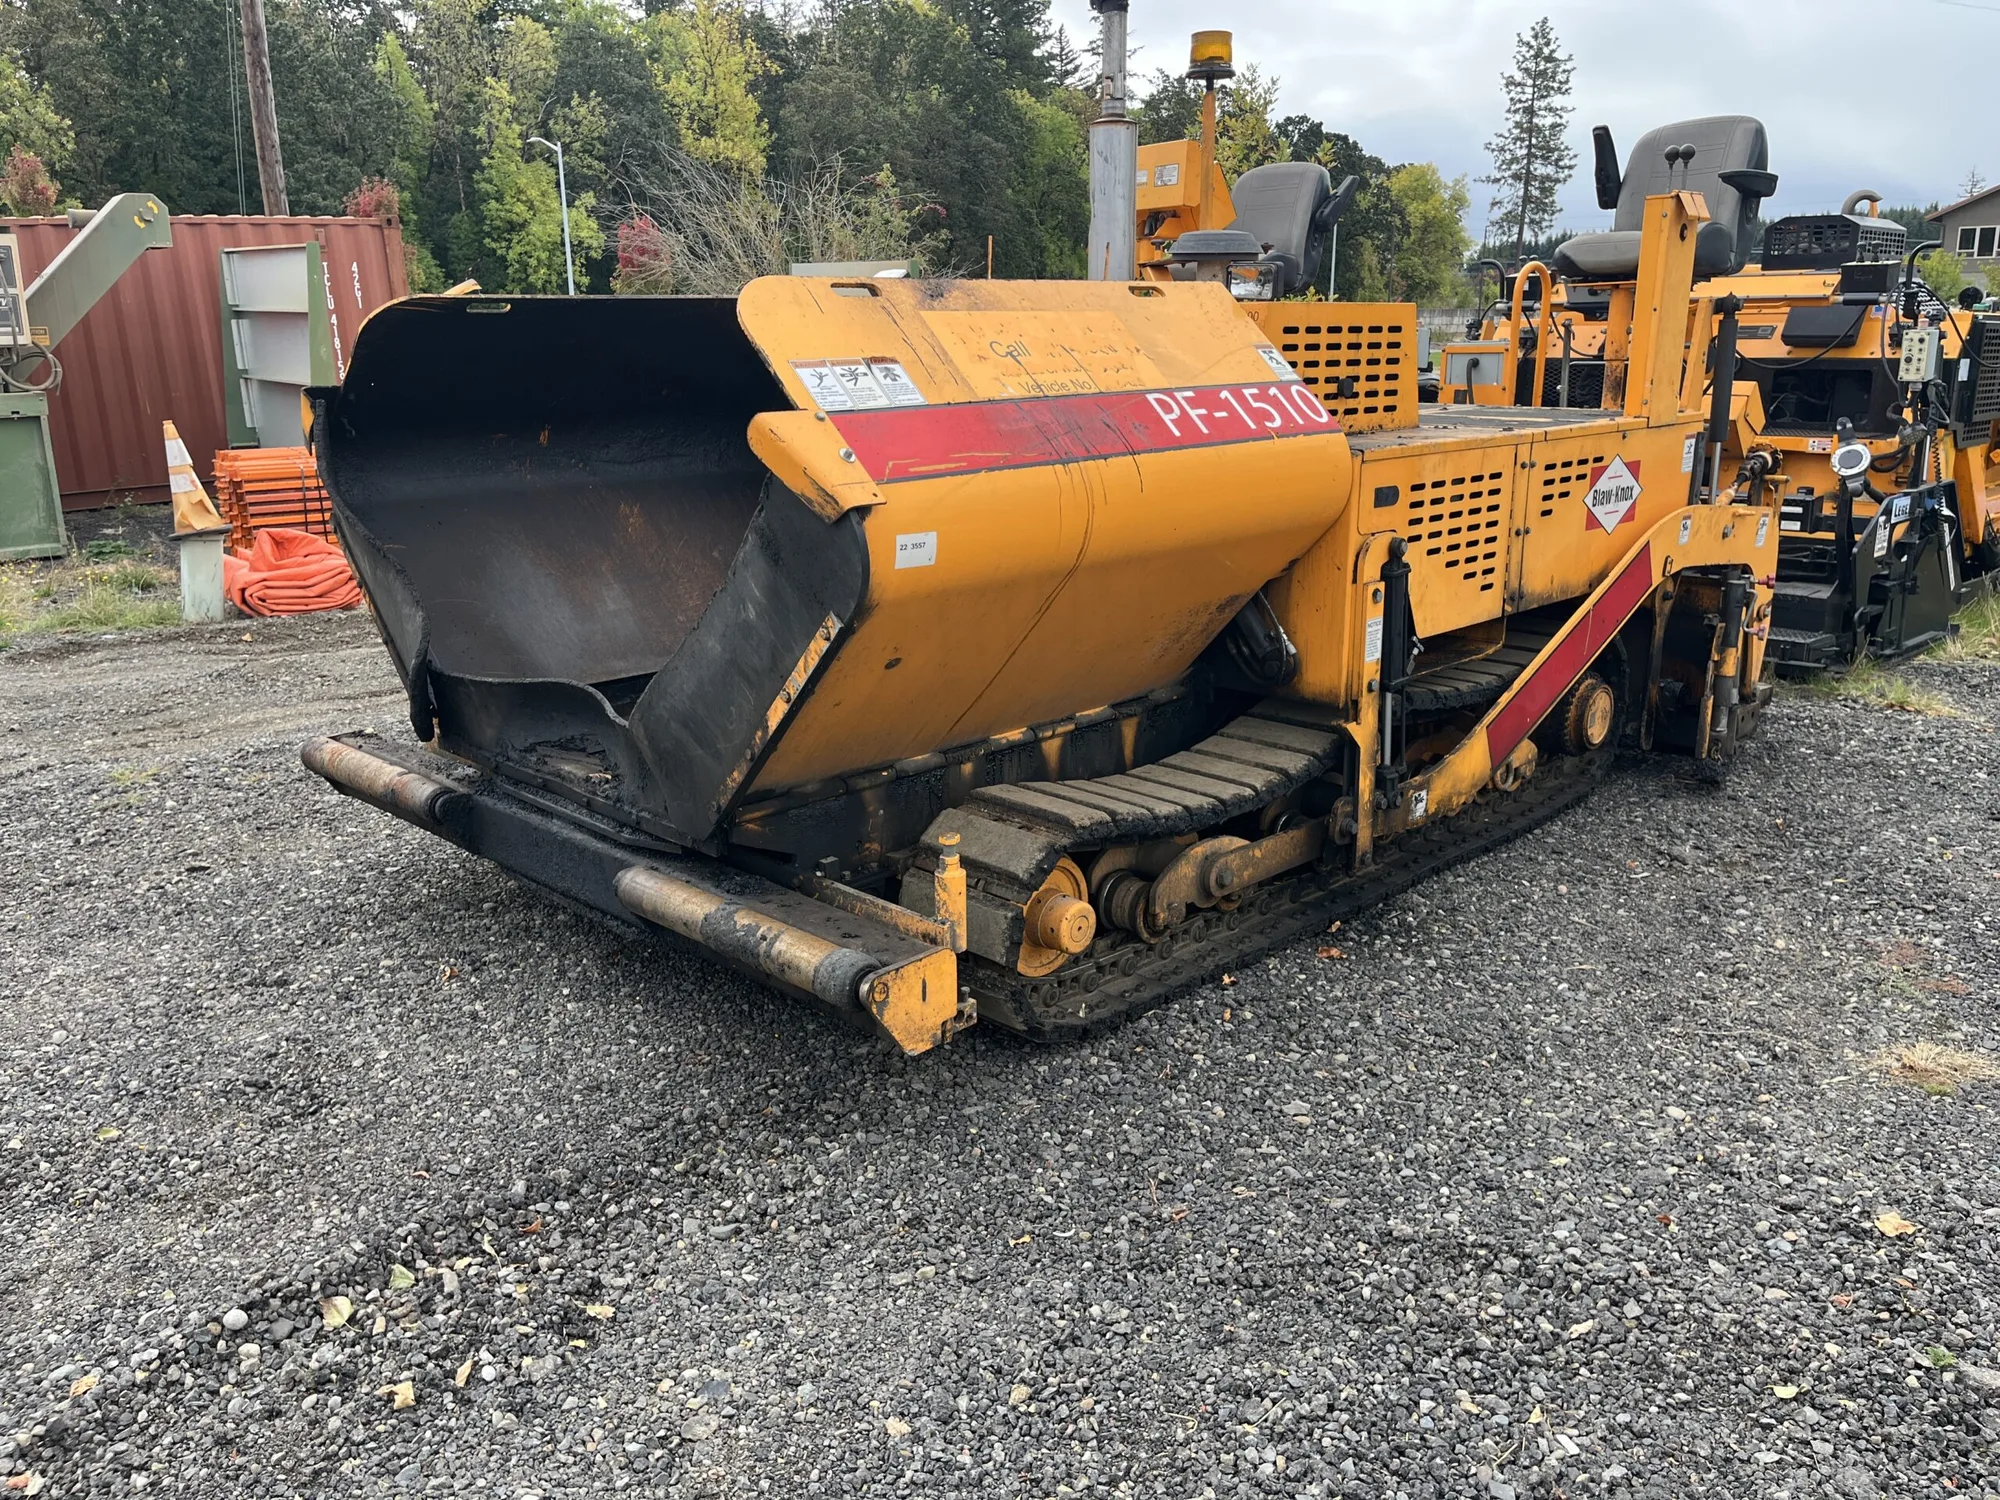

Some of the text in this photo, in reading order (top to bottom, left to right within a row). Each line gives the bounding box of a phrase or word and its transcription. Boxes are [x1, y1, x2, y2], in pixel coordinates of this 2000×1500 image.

[321, 261, 334, 310] TCLU
[352, 261, 363, 309] 42G1
[989, 340, 1031, 359] Call
[1018, 380, 1071, 396] Vehicle
[1145, 384, 1329, 437] PF-1510
[1592, 484, 1635, 508] Blaw-Knox
[899, 541, 926, 551] 22 3557
